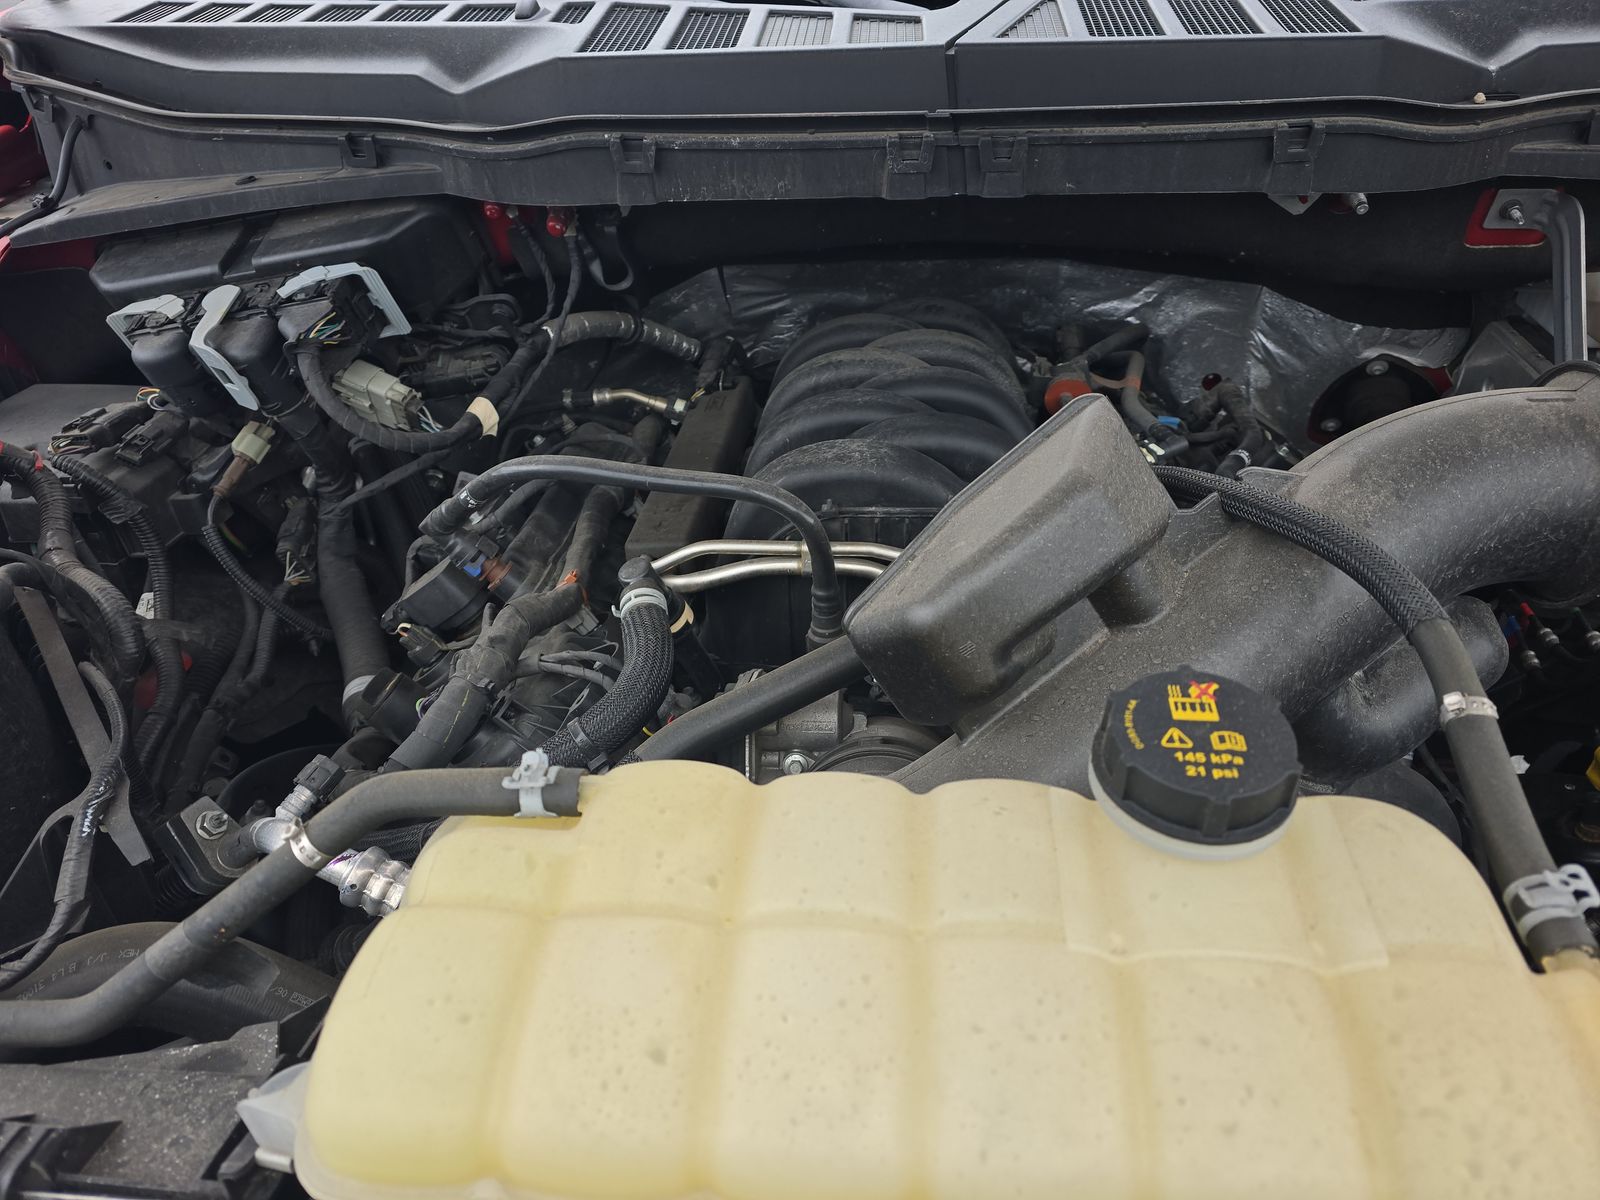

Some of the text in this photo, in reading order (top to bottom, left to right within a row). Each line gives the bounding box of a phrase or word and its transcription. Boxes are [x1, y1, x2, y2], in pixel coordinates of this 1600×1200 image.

[1174, 751, 1245, 766] 145 kPa
[1185, 765, 1240, 780] 21 psi
[118, 948, 140, 958] MEX
